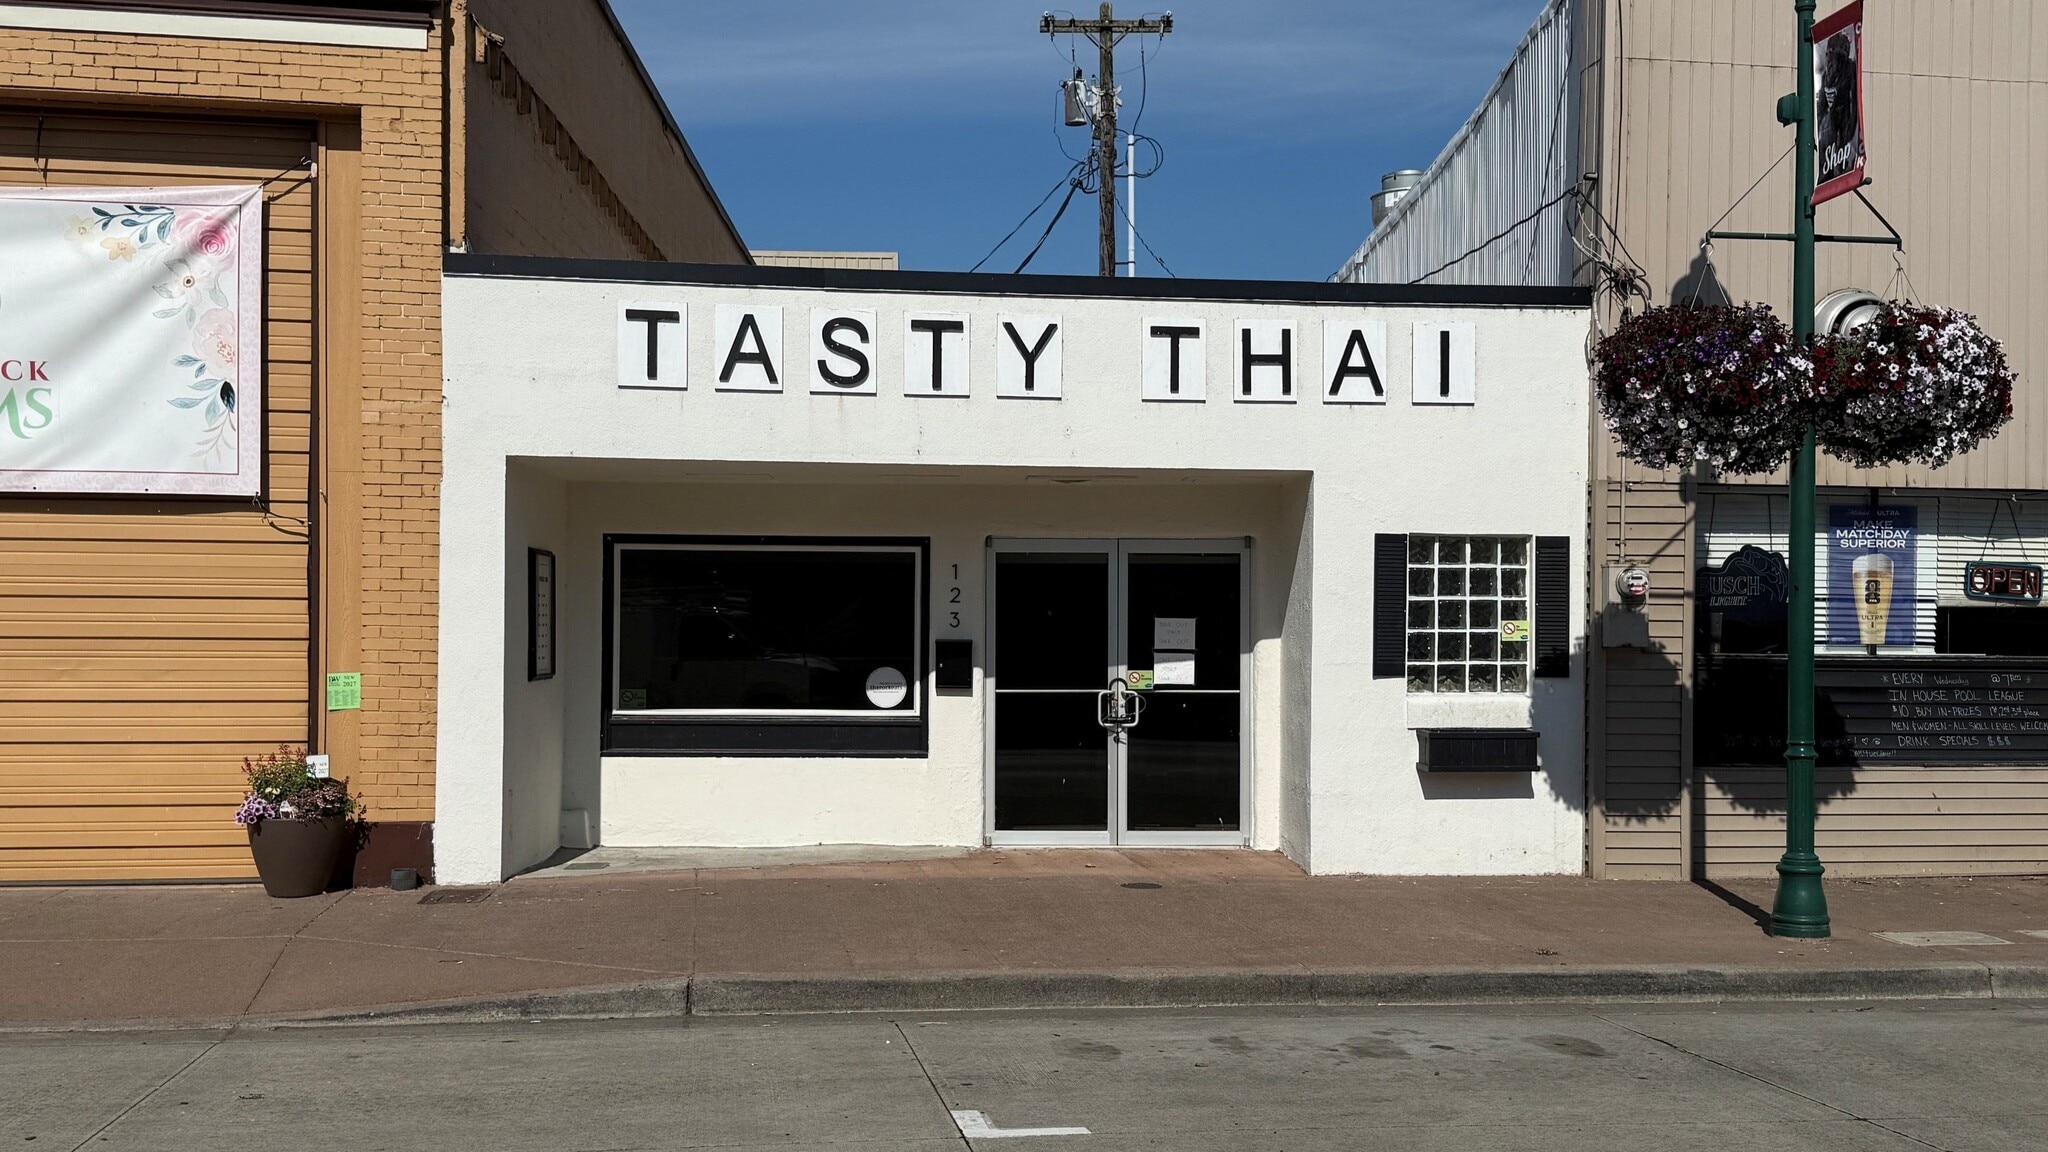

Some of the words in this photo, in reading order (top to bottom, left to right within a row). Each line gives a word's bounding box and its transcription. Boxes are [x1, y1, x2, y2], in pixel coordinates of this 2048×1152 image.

[1823, 142, 1851, 175] Shop
[625, 308, 1058, 391] TASTY
[1150, 325, 1450, 398] THAI
[1853, 520, 1894, 529] MAKE
[1836, 529, 1910, 539] MATCHDAY
[1840, 539, 1906, 548] SUPERIOR
[1972, 566, 2041, 596] OPEN
[1892, 672, 1924, 685] EVERY
[1889, 689, 1907, 701] IN
[1913, 689, 1948, 702] HOUSE
[1954, 689, 1981, 702] POOL
[1989, 690, 2024, 701] LEAGUE
[1915, 706, 1932, 717] BUY
[1891, 721, 1909, 731] MEN
[1969, 721, 1989, 731] SKILL
[1991, 722, 2017, 731] LEVELS
[1898, 735, 1930, 747] DRINK
[1939, 735, 1979, 747] SPECIALS
